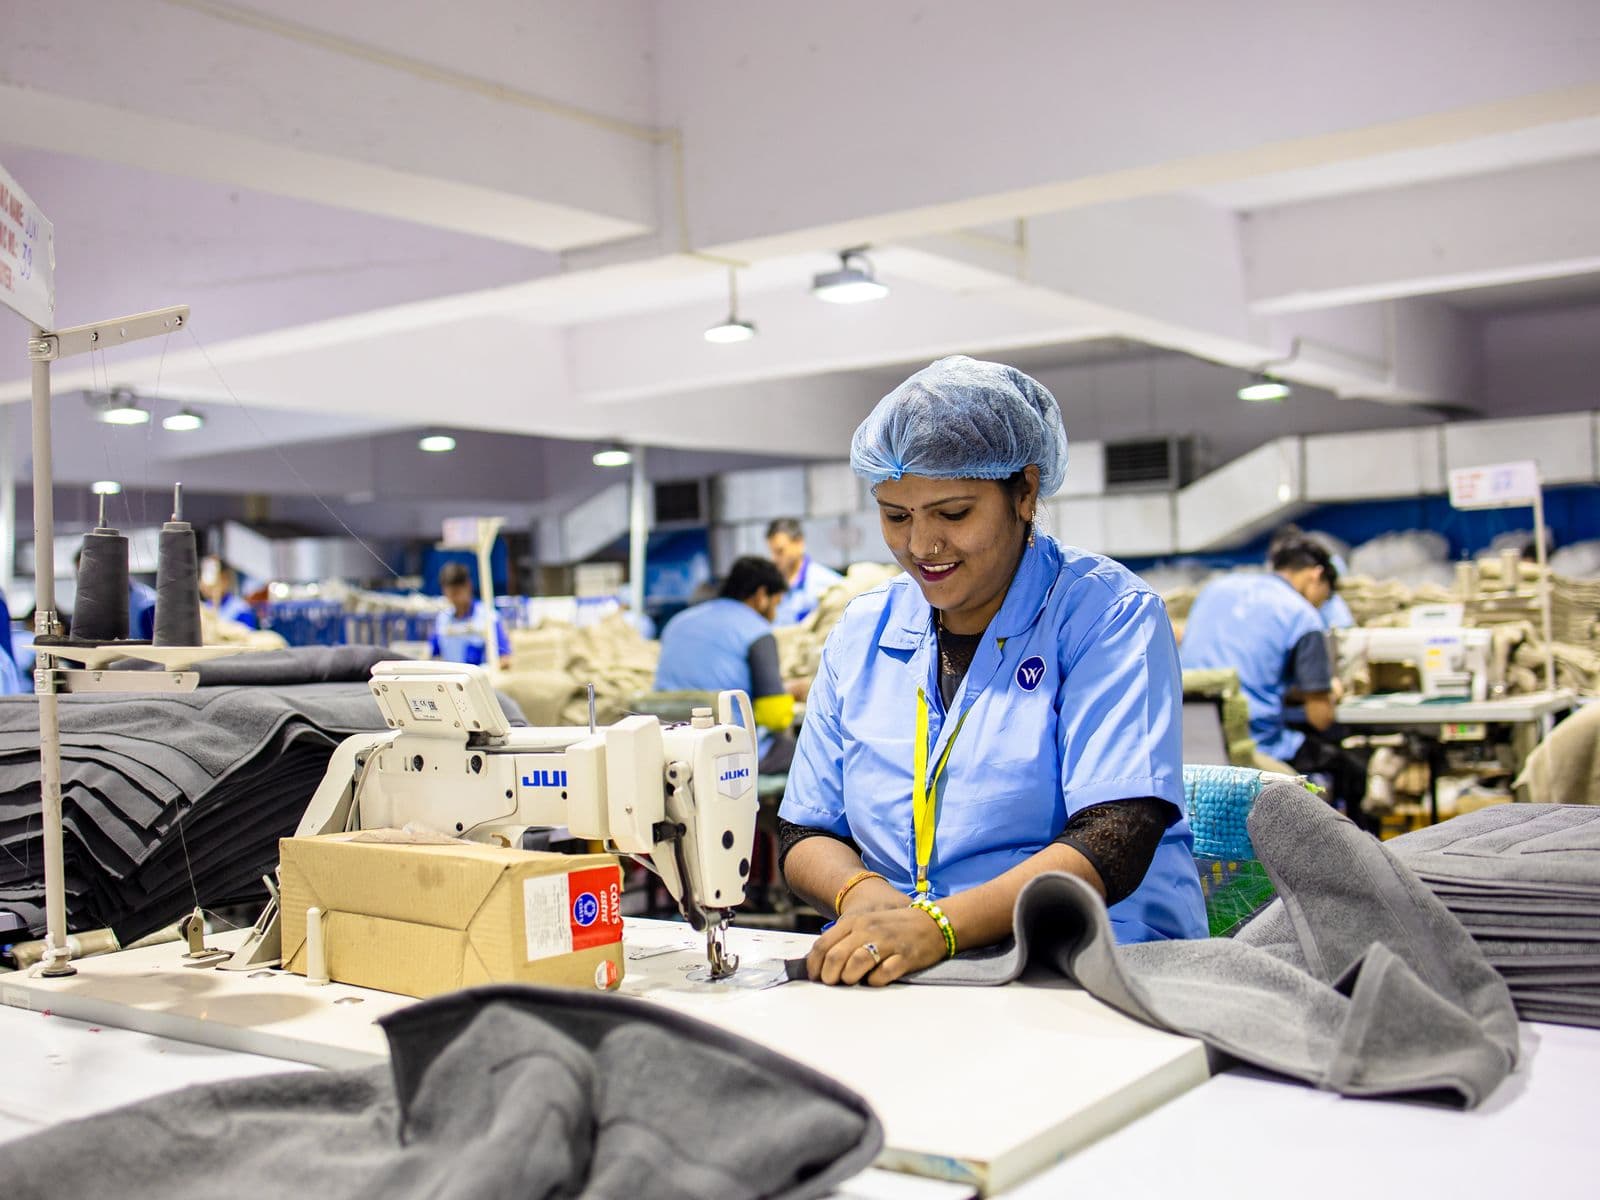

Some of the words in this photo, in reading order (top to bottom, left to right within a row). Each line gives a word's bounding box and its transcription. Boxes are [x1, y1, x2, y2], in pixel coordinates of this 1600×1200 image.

[1020, 667, 1044, 684] W
[720, 768, 749, 781] JUKI
[609, 883, 621, 925] COATS
